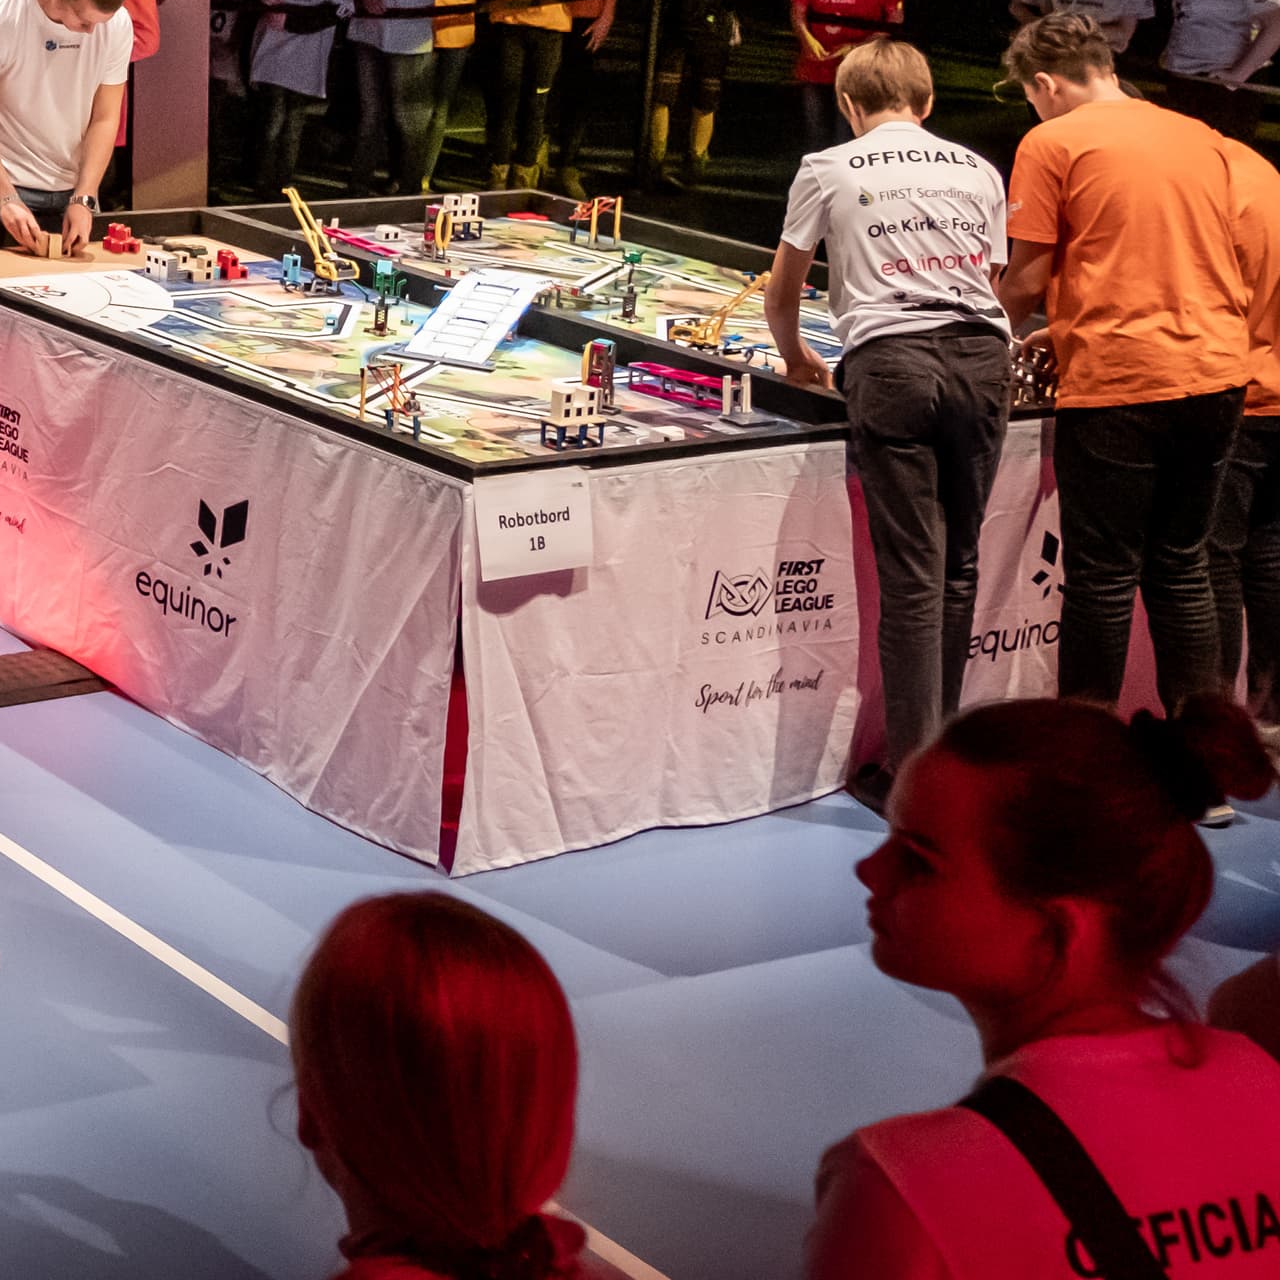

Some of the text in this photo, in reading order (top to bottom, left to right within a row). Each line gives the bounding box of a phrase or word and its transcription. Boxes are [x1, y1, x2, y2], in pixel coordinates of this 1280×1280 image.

[849, 149, 978, 169] OFFICIALS
[879, 187, 913, 202] FIRST
[868, 222, 897, 238] Ole
[498, 506, 571, 530] Robotbord
[529, 535, 546, 552] 1B
[777, 558, 826, 578] FIRST
[775, 578, 818, 596] LEGO
[135, 571, 238, 638] equinor
[774, 594, 835, 615] LEAGUE
[700, 618, 833, 646] SCANDINAVIA
[967, 618, 1061, 663] equino
[694, 666, 825, 714] Sport for the mind
